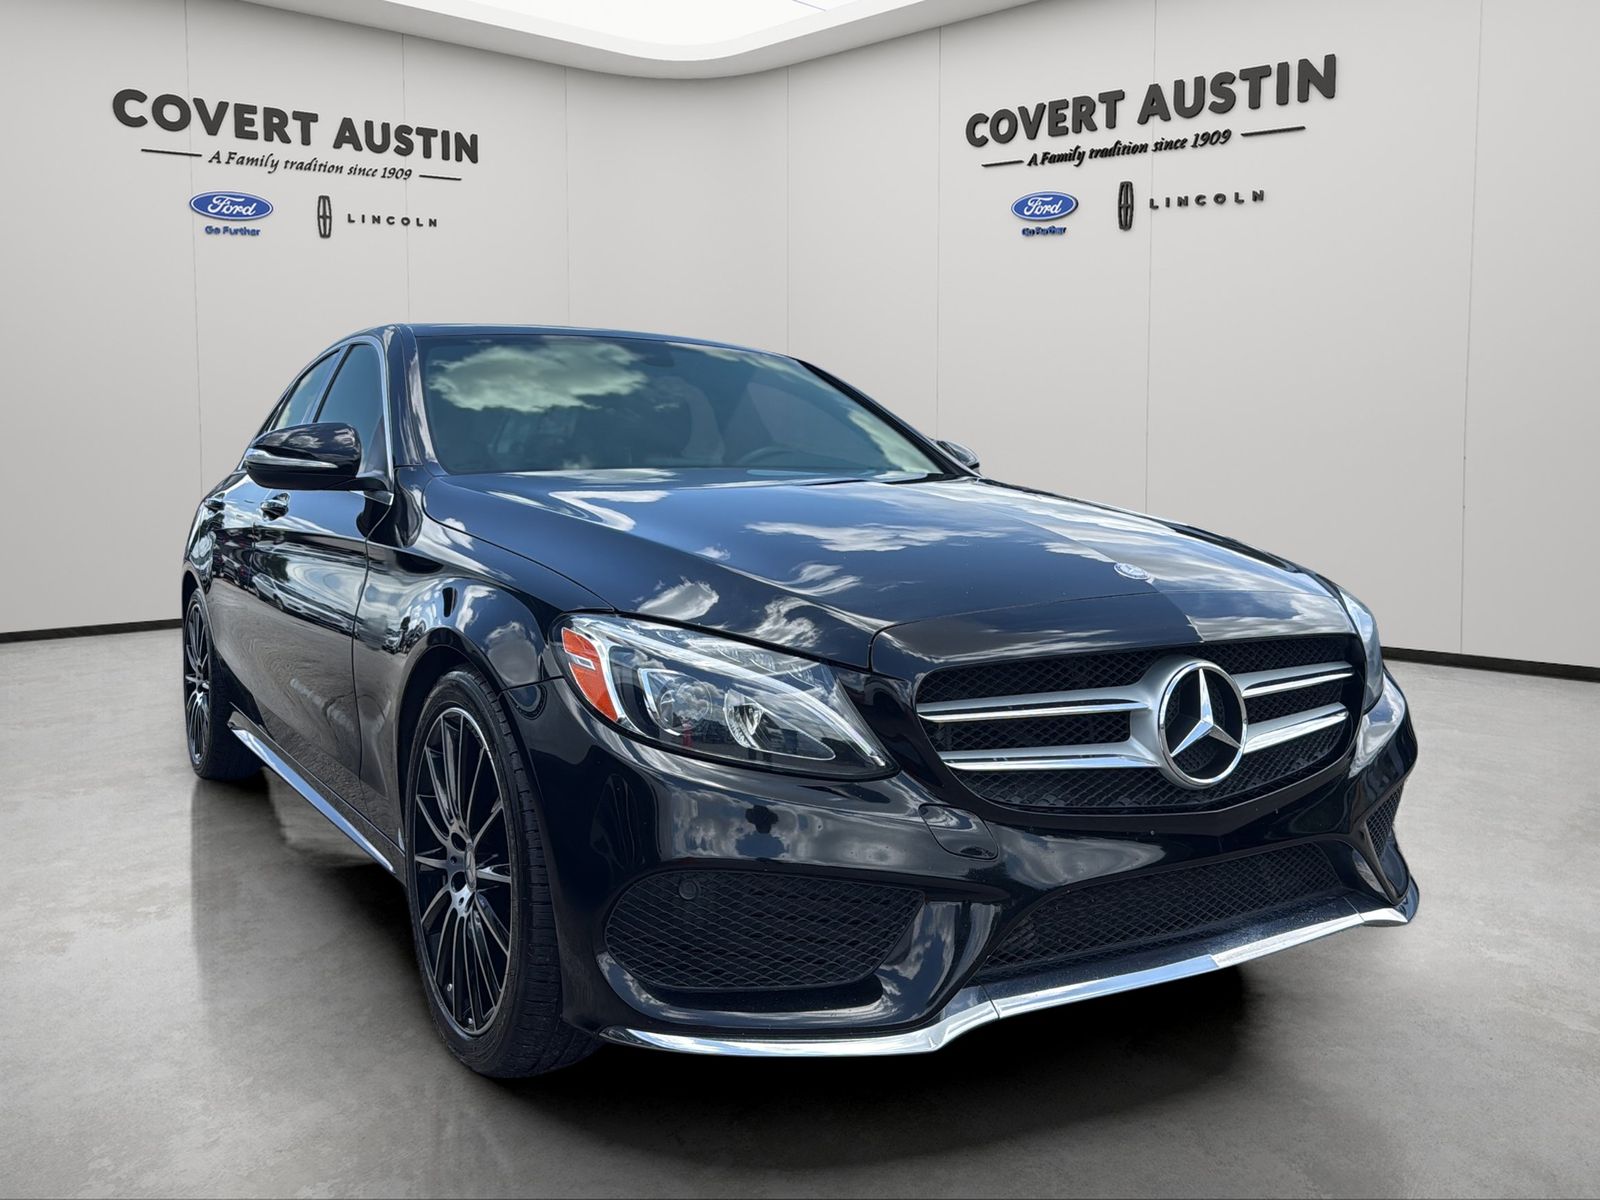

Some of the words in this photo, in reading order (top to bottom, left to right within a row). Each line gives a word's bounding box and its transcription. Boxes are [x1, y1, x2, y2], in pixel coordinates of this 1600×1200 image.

[965, 89, 1125, 147] COVERT
[1137, 53, 1337, 125] AUSTIN
[112, 89, 319, 146] COVERT
[333, 117, 479, 164] AUSTIN
[1027, 153, 1038, 167] A
[1039, 145, 1087, 168] Family
[1088, 140, 1149, 160] tradition
[1152, 137, 1188, 152] since
[1190, 128, 1232, 149] 1909
[208, 150, 222, 164] A
[225, 151, 280, 174] Family
[283, 157, 344, 175] tradition
[347, 164, 378, 178] since
[380, 166, 413, 180] 1909
[207, 195, 258, 216] Ford
[1023, 196, 1063, 216] Ford
[1149, 189, 1266, 210] LINCOLN
[205, 225, 220, 235] Go
[222, 226, 261, 236] Further
[347, 213, 438, 228] LINCOLN
